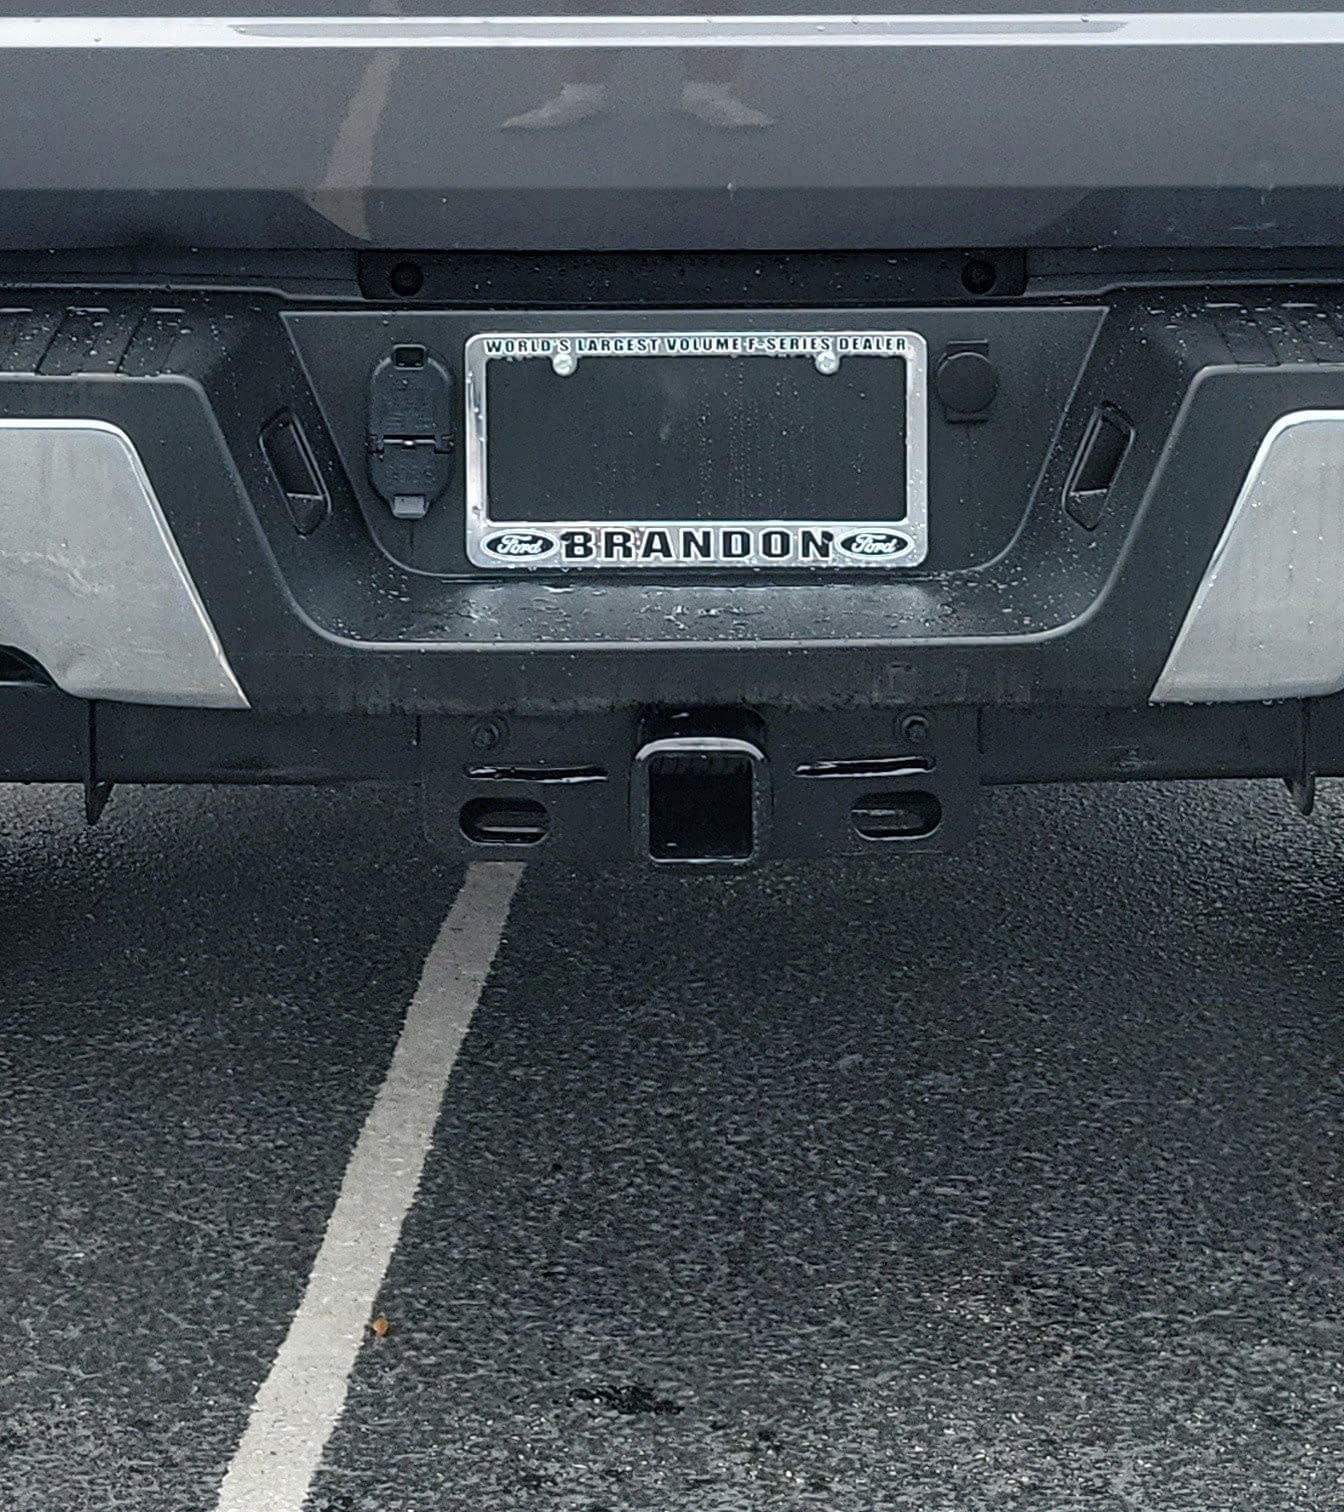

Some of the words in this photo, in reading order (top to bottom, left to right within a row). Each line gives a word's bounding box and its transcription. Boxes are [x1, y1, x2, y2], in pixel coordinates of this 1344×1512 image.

[486, 338, 570, 354] WORLD'S
[577, 338, 659, 353] LARGEST
[666, 338, 741, 353] VOLUME
[747, 337, 832, 351] F-SERIES
[839, 337, 905, 351] DEALER
[496, 534, 543, 555] Ford
[560, 530, 834, 558] BRANDON
[850, 533, 899, 554] Ford
